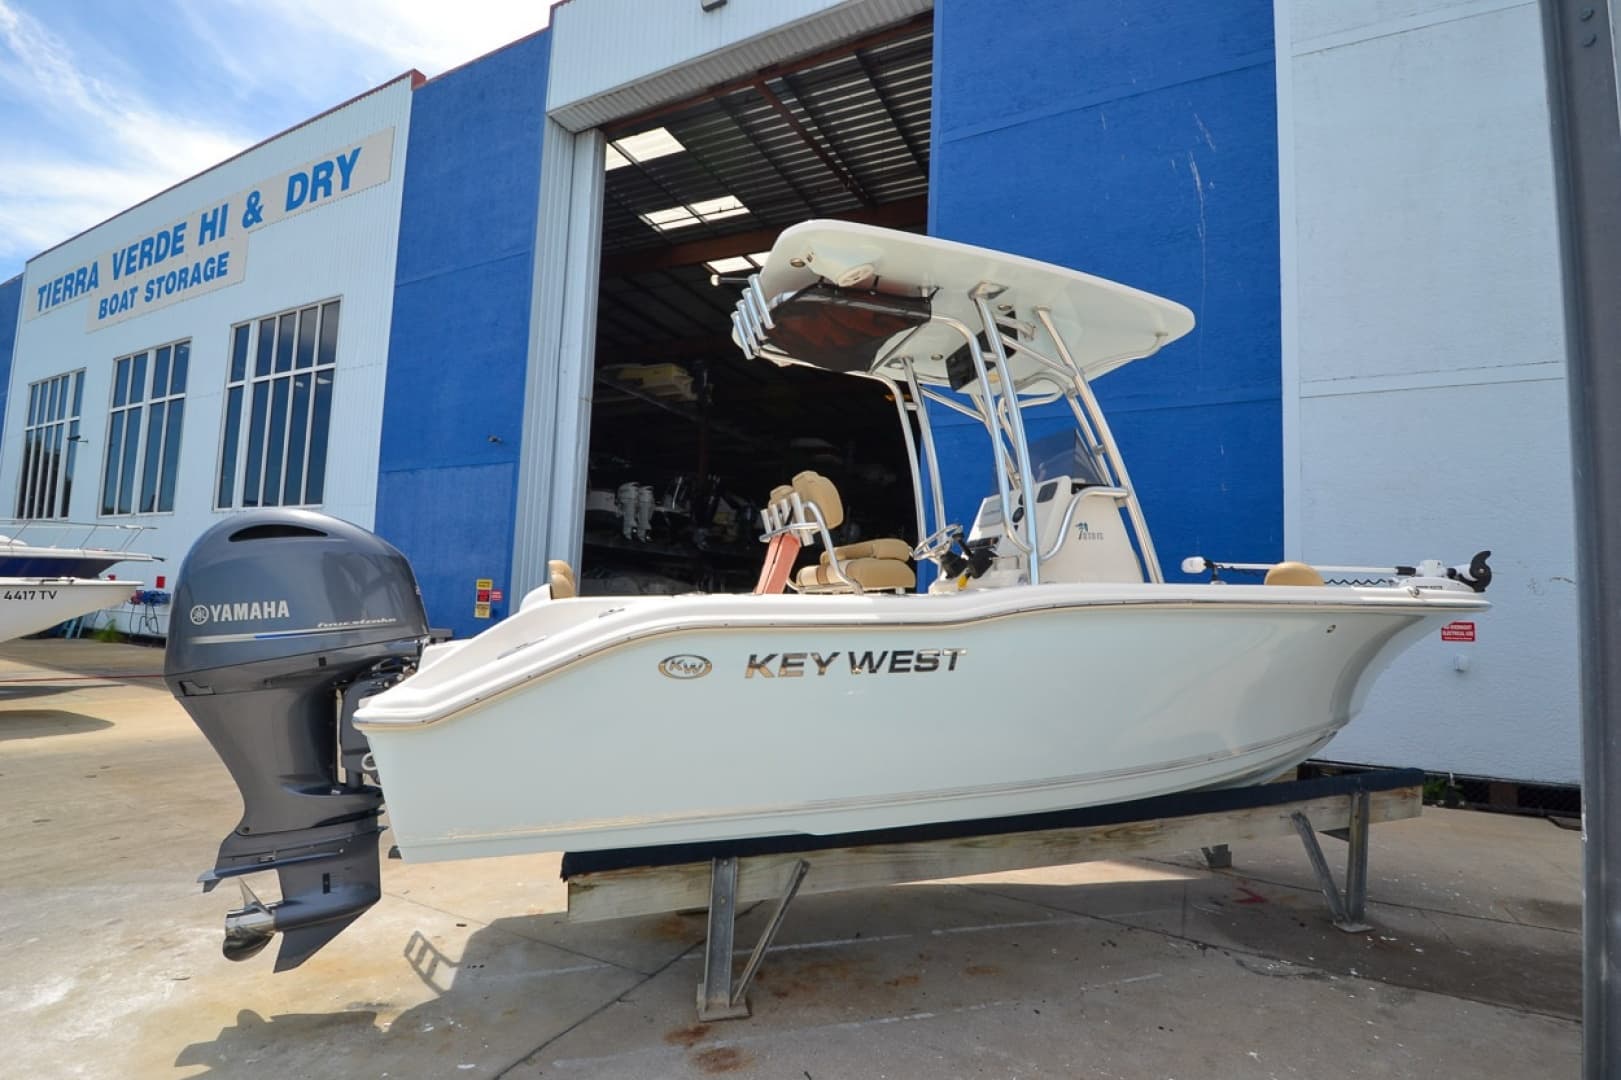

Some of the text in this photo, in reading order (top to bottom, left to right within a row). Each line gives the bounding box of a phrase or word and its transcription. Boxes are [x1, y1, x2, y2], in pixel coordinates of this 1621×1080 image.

[37, 147, 362, 312] TIERRA VERDE HI & DRY
[98, 252, 229, 319] BOAT STORAGE
[4, 590, 57, 600] 4417 TV
[210, 600, 290, 622] YAMAHA
[744, 648, 967, 680] KEY WEST
